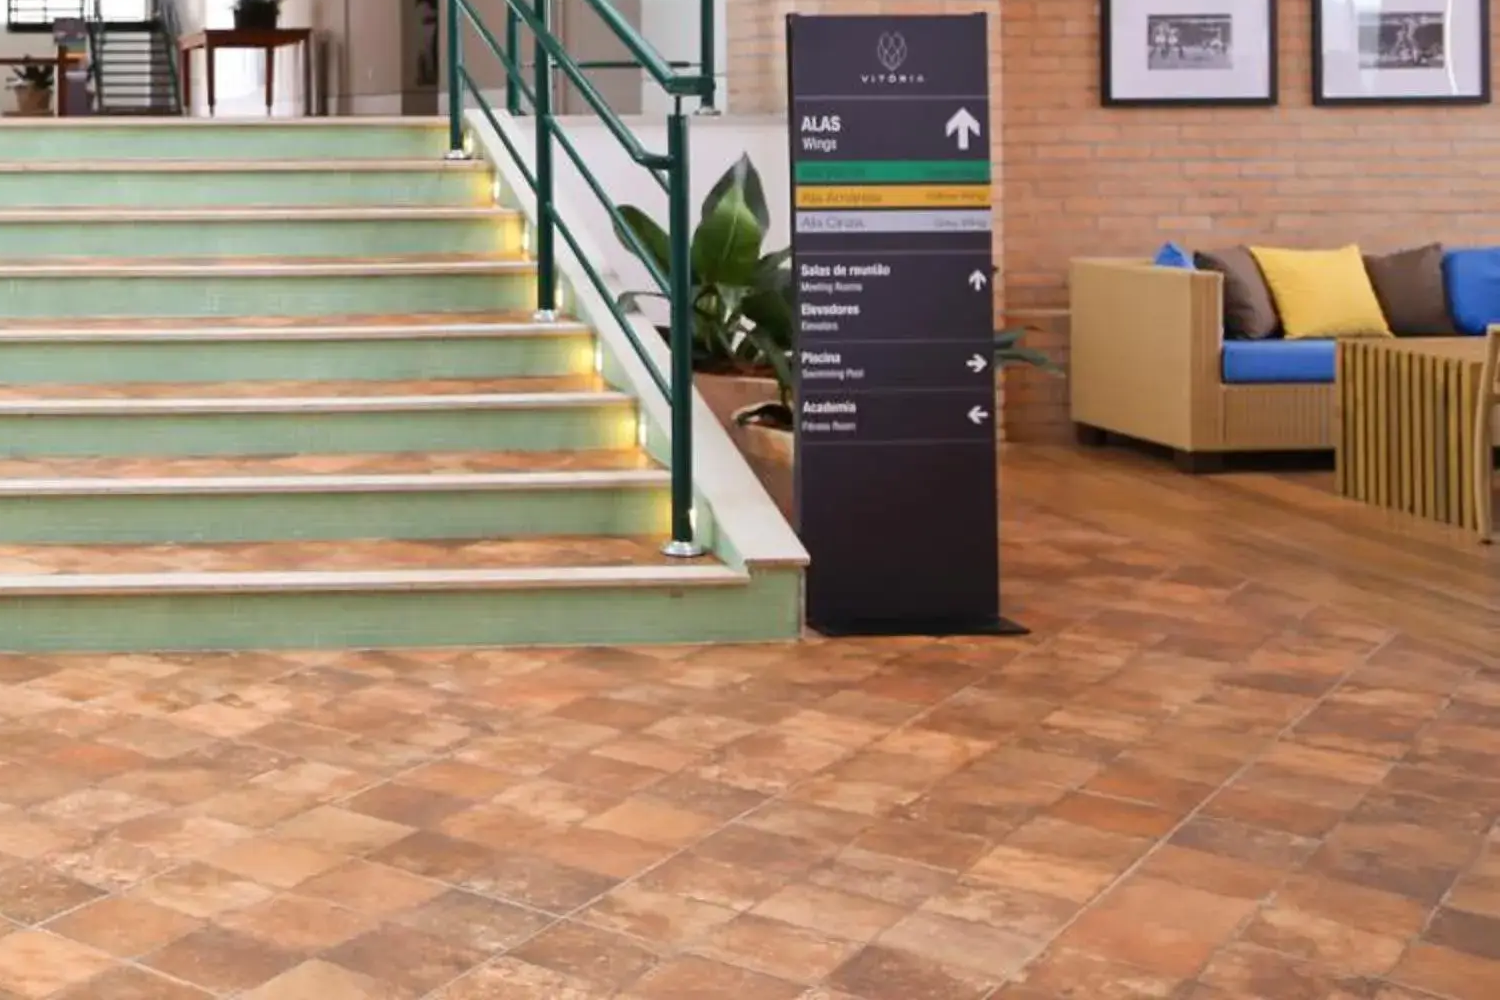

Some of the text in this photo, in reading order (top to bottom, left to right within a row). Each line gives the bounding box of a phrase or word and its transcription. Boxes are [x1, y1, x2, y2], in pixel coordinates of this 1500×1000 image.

[801, 115, 841, 132] ALAS
[802, 137, 837, 152] Wings
[802, 216, 823, 228] Ala
[801, 262, 891, 277] Salas de reunião
[801, 303, 860, 316] Elevadores
[801, 351, 841, 365] Piscina
[803, 400, 857, 414] Academia
